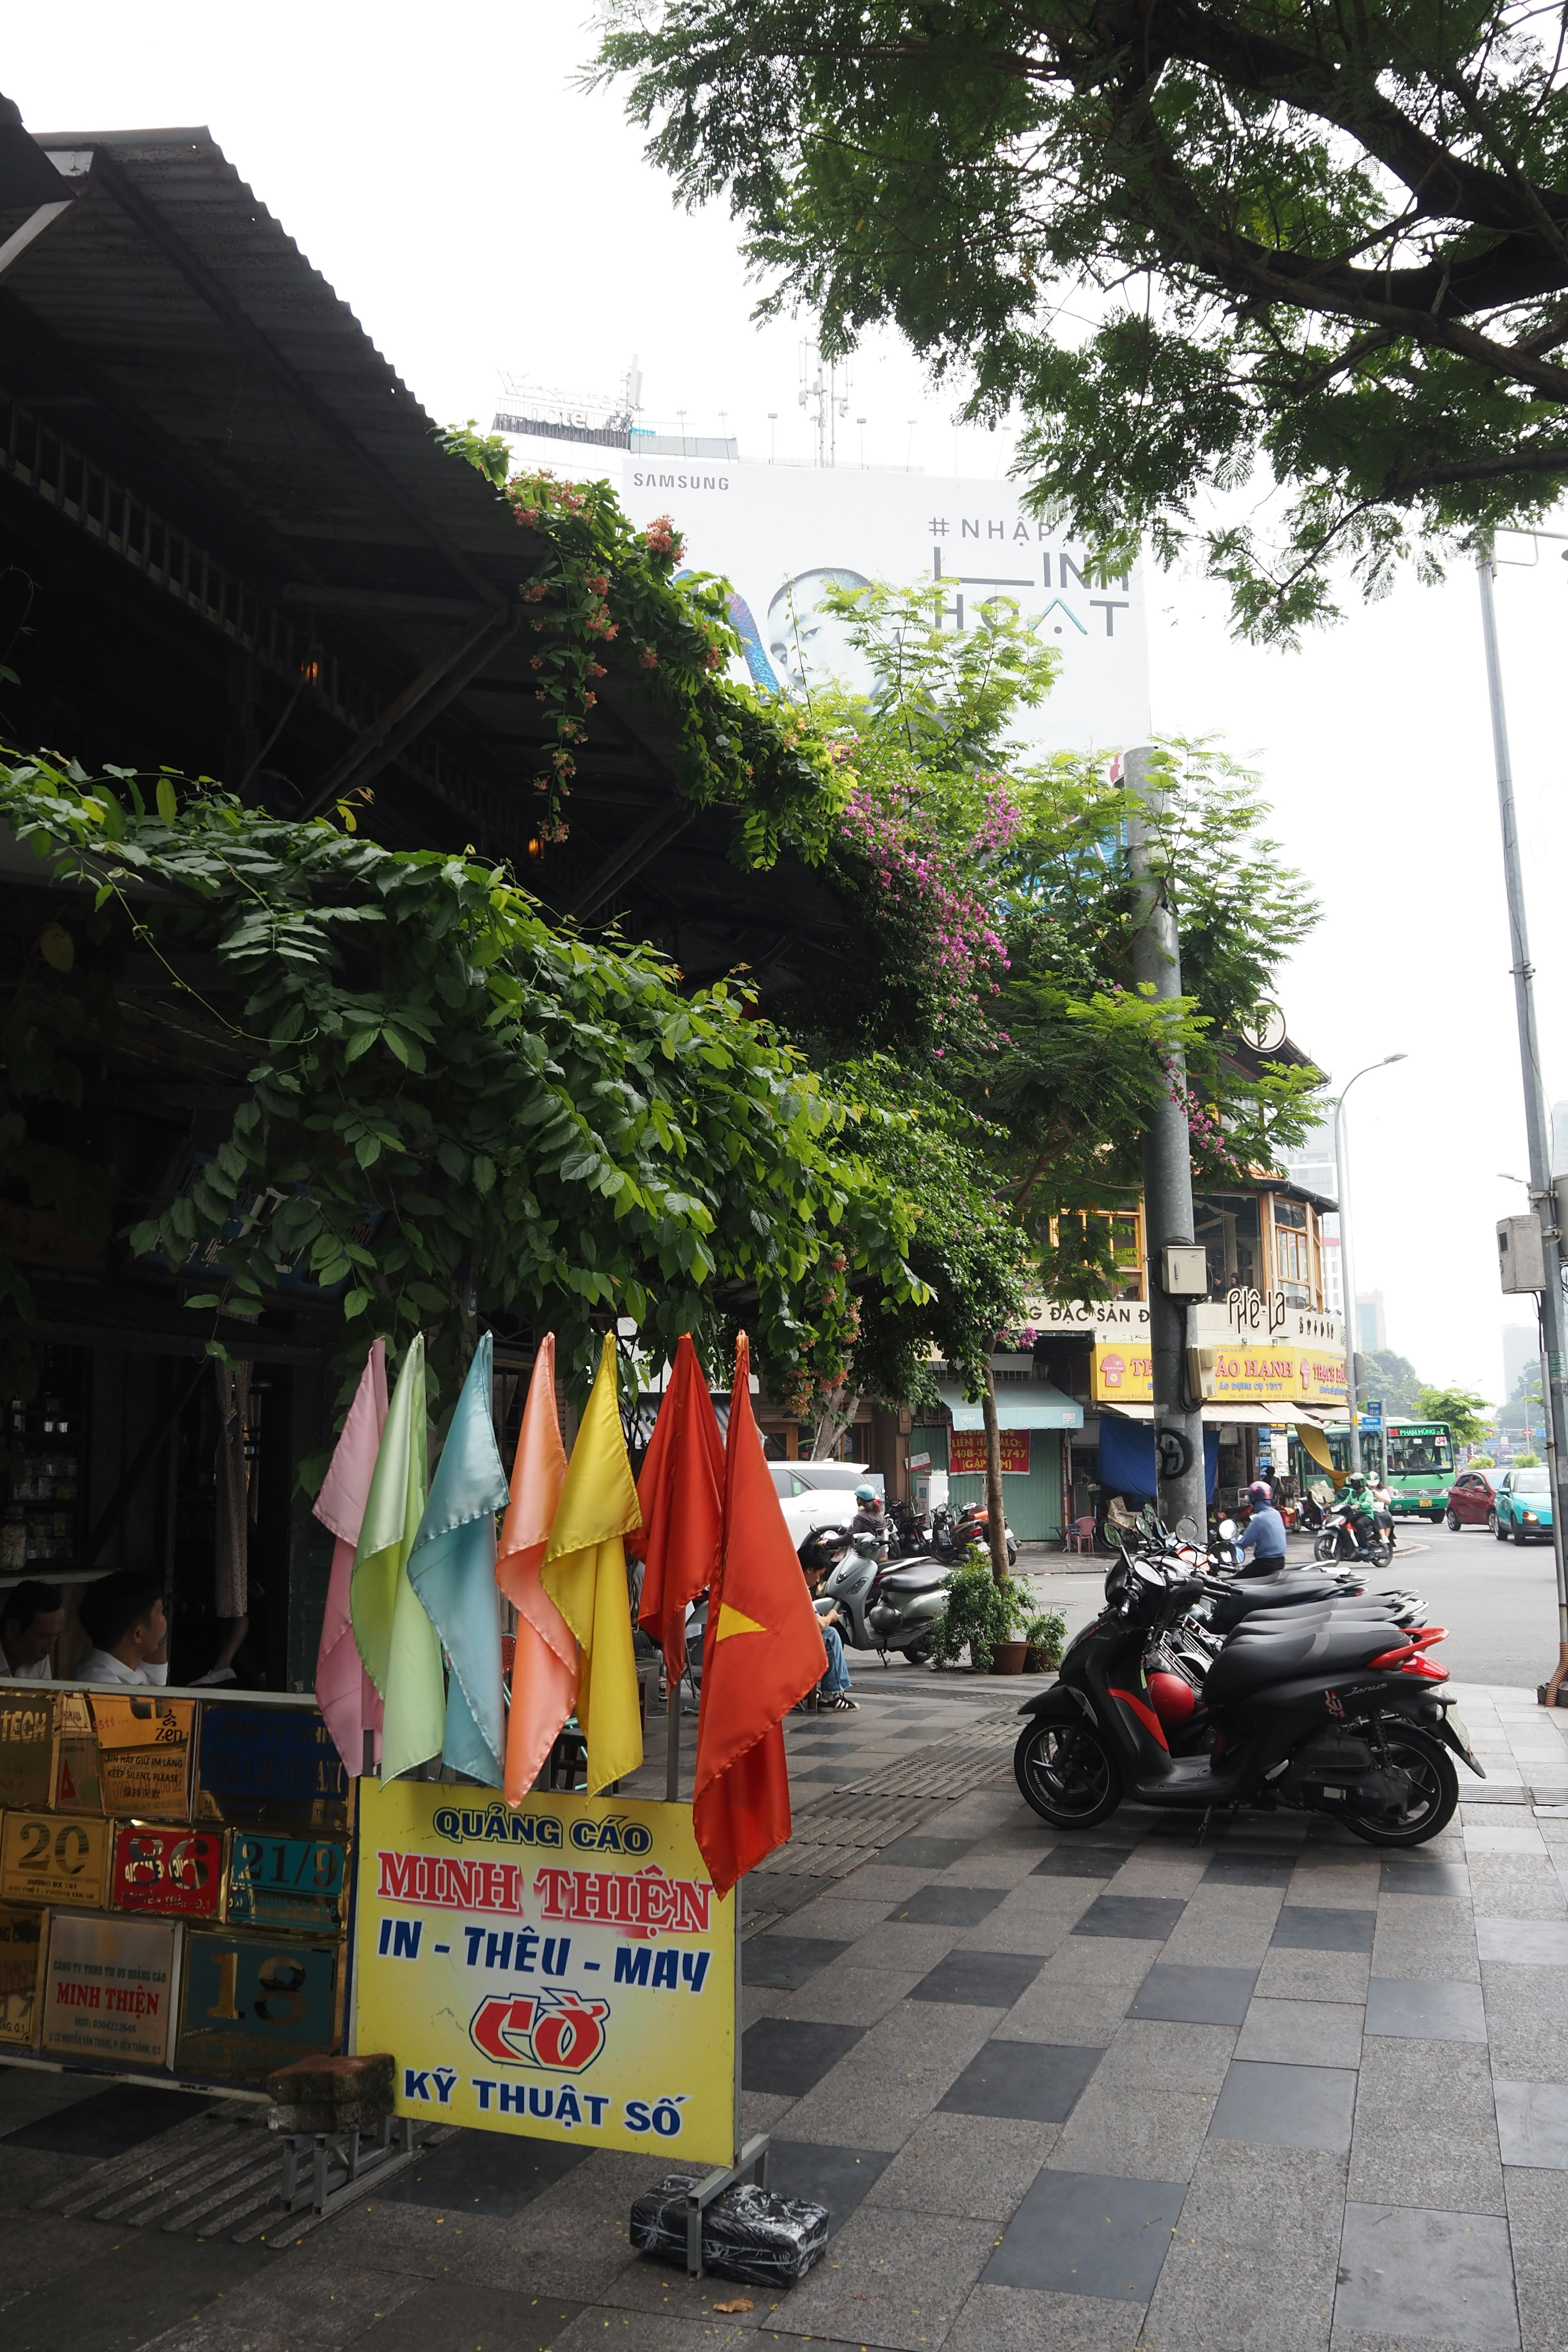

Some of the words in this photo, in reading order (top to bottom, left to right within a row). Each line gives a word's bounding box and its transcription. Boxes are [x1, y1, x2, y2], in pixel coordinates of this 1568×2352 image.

[633, 473, 729, 490] SAMSUNG
[1097, 1303, 1130, 1322] SẢN
[1216, 1355, 1240, 1377] ẢO
[1245, 1361, 1293, 1380] HẠNH
[1232, 1382, 1252, 1392] DỤNG
[1254, 1382, 1264, 1392] CỤ
[1266, 1382, 1283, 1390] TDTT
[951, 1437, 973, 1448] LIÊN
[1000, 1438, 1022, 1447] ALO:
[1344, 1682, 1388, 1697] Janus
[105, 1755, 118, 1763] XIN
[120, 1754, 134, 1764] HÃY
[108, 1770, 125, 1778] KEEP
[127, 1771, 151, 1781] SILENT,
[153, 1773, 178, 1783] PLEASE
[19, 1821, 89, 1874] 20
[433, 1802, 563, 1849] QUẢNG
[569, 1816, 653, 1856] CÁO
[125, 1835, 209, 1891] 86
[238, 1842, 337, 1889] 21/9
[376, 1851, 522, 1916] MINH
[533, 1863, 716, 1939] THIỆN
[377, 1919, 423, 1959] IN
[464, 1925, 571, 1977] THÊU
[613, 1946, 711, 1993] MAY
[152, 1969, 166, 1983] CÁO
[207, 1952, 307, 2028] 18
[56, 1982, 101, 2009] MINH
[105, 1984, 159, 2019] THIỆN
[470, 1986, 610, 2075] CỜ
[404, 2068, 457, 2103] KỸ
[472, 2078, 610, 2127] THUẬT
[624, 2094, 690, 2136] SỐ
